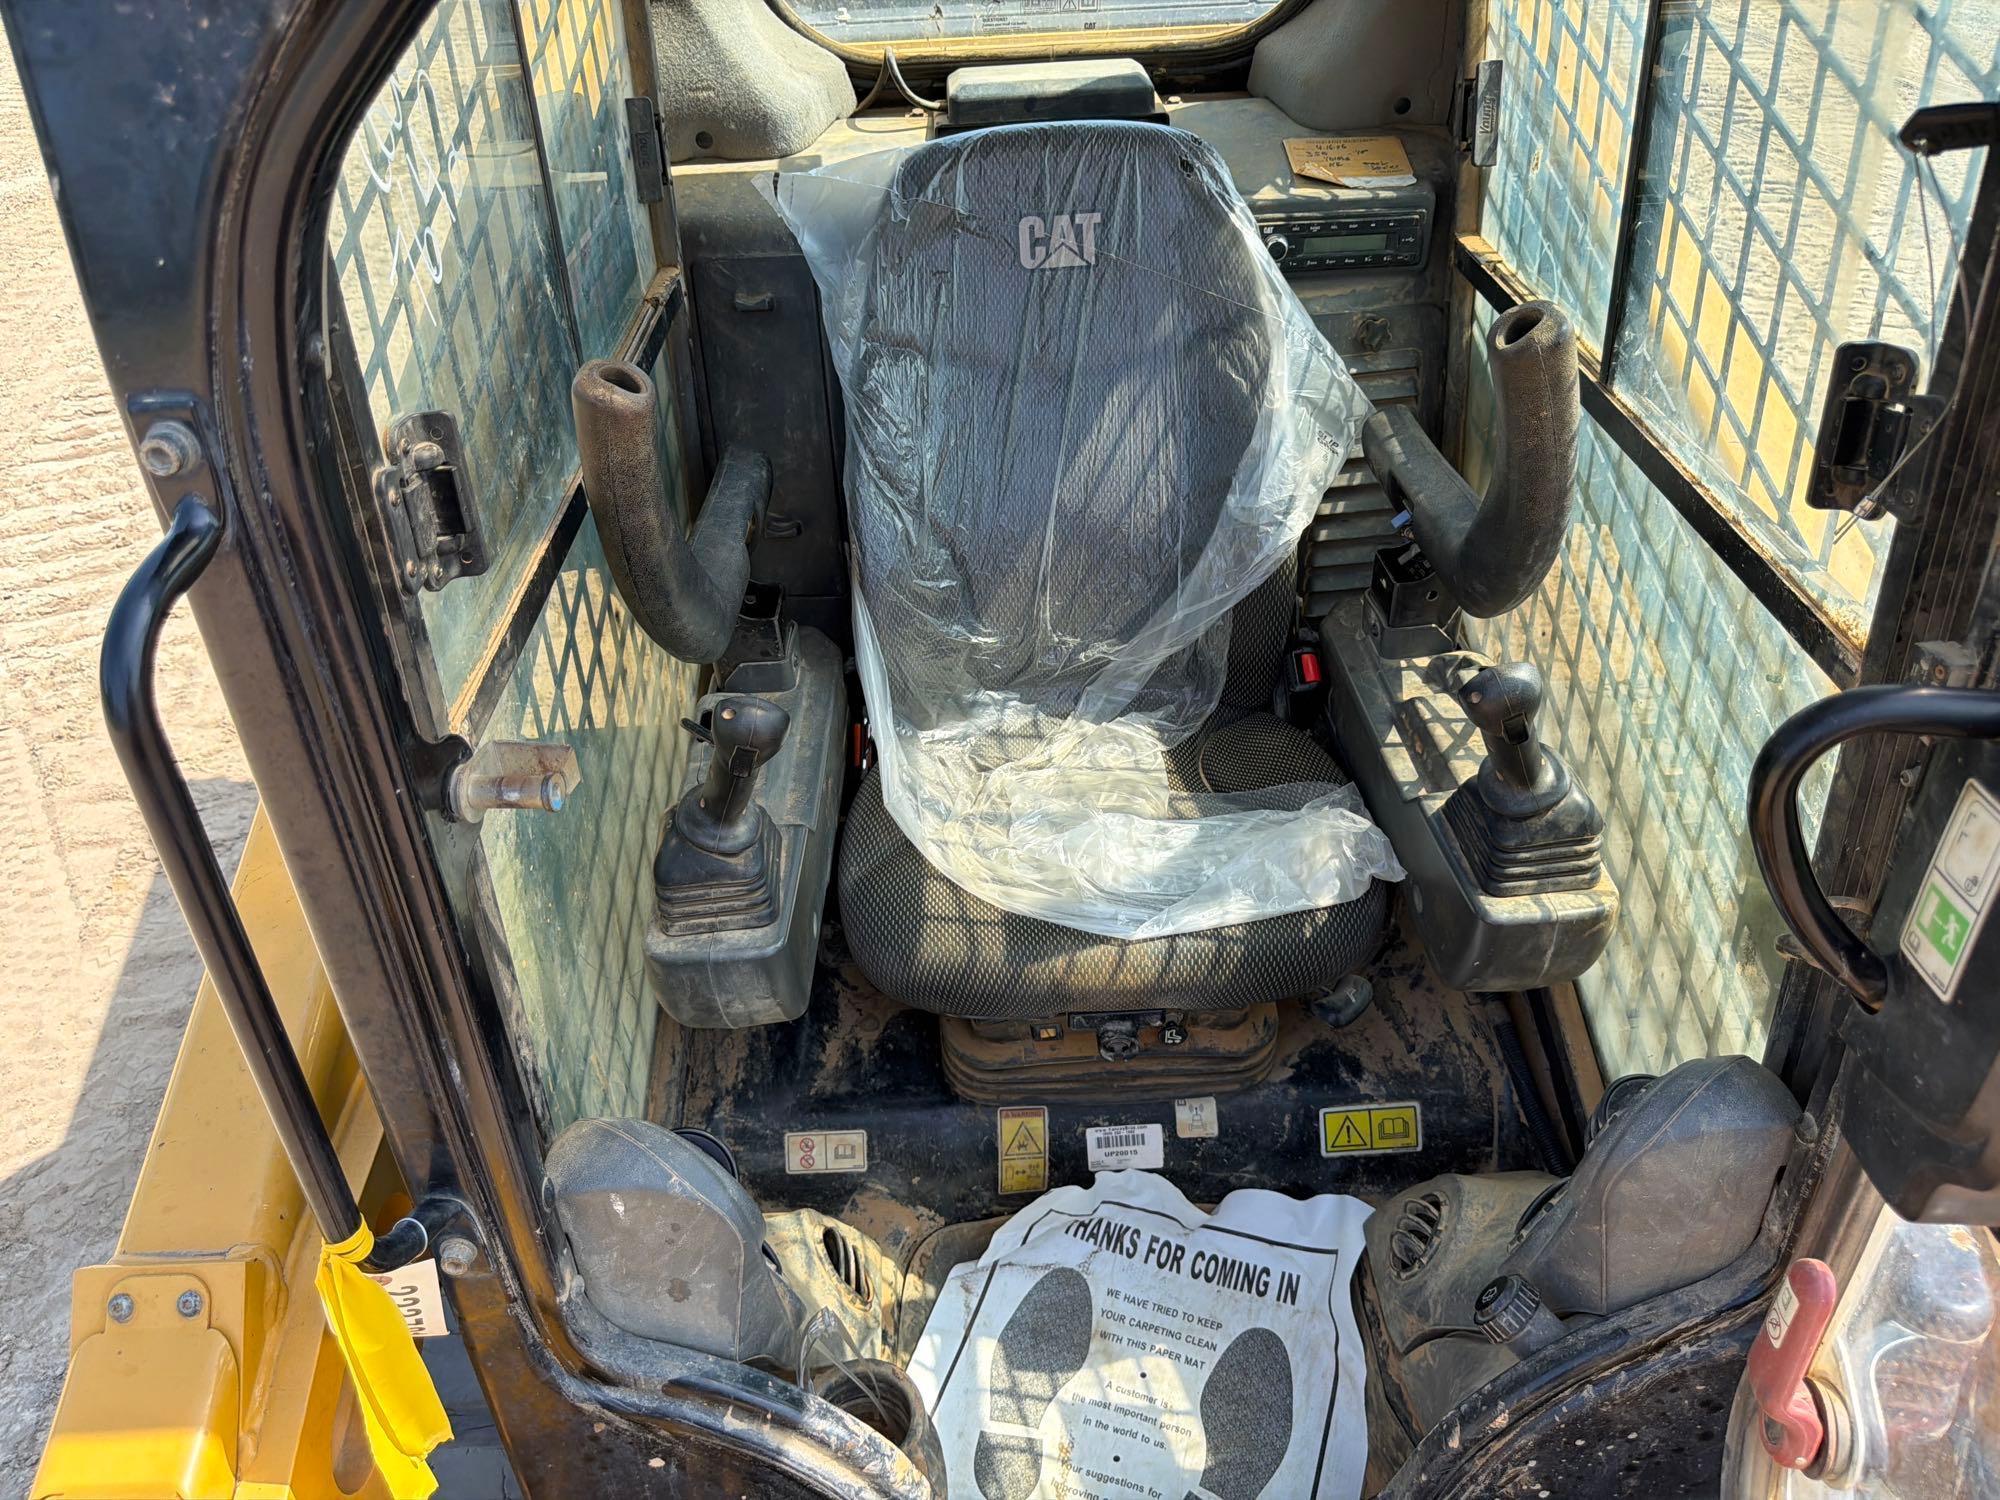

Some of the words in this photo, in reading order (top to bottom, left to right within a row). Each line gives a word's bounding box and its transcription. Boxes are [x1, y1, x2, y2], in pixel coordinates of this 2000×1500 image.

[1083, 22, 1097, 30] CAT
[1018, 212, 1101, 269] CAT
[1104, 1149, 1139, 1158] UP20015
[1143, 1234, 1186, 1275] FOR
[1190, 1250, 1271, 1298] COMING
[1275, 1270, 1301, 1306] IN
[1100, 1307, 1127, 1325] YOUR
[1128, 1317, 1182, 1341] CARPETING
[1184, 1334, 1218, 1352] CLEAN
[1106, 1287, 1122, 1300] WE
[1123, 1292, 1150, 1310] HAVE
[1152, 1302, 1179, 1319] TRIED
[1182, 1311, 1195, 1323] TO
[1197, 1316, 1223, 1331] KEEP
[1099, 1329, 1123, 1344] WITH
[1126, 1337, 1147, 1351] THIS
[1149, 1344, 1182, 1361] PAPER
[1184, 1354, 1206, 1371] MAT
[1105, 1380, 1113, 1390] A
[1115, 1385, 1158, 1406] customer
[1071, 1391, 1086, 1403] the
[1087, 1398, 1112, 1411] most
[1114, 1403, 1158, 1426] important
[1159, 1420, 1192, 1438] person
[1083, 1415, 1092, 1426] in
[1094, 1419, 1110, 1431] the
[1112, 1425, 1139, 1440] world
[1140, 1433, 1151, 1444] to
[1153, 1439, 1167, 1450] us.
[1085, 1468, 1145, 1493] suggestions
[1147, 1486, 1163, 1500] for
